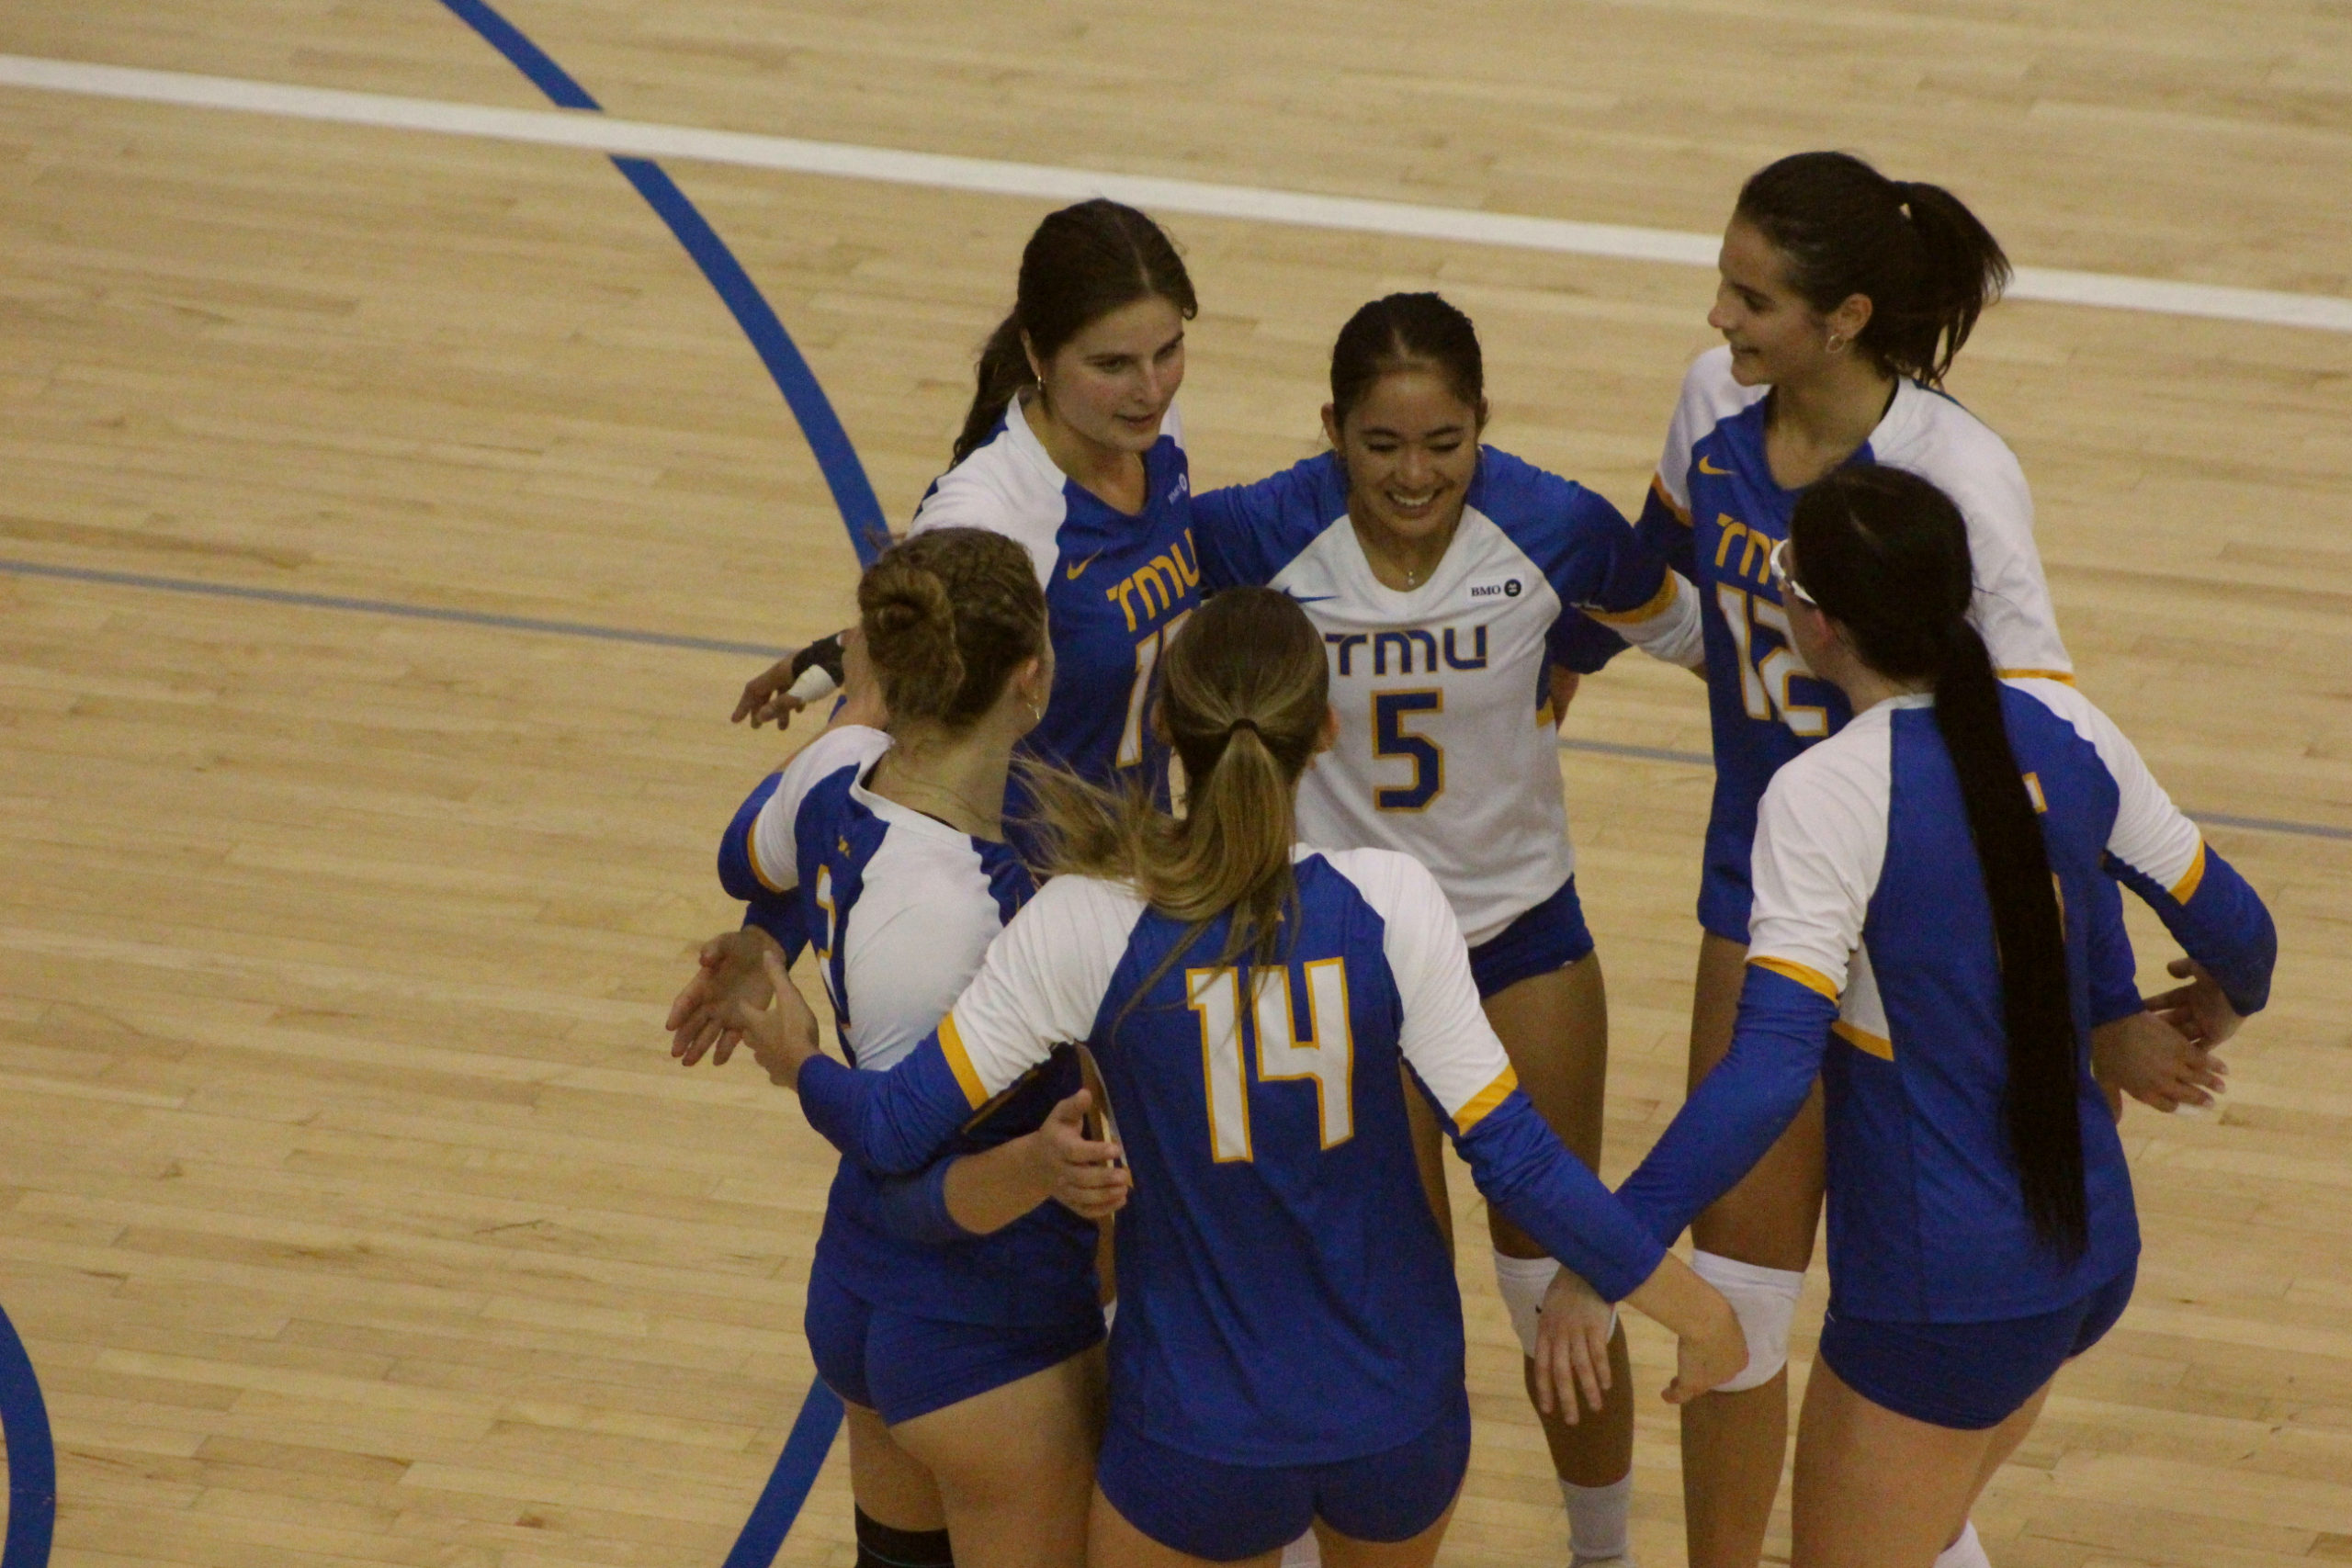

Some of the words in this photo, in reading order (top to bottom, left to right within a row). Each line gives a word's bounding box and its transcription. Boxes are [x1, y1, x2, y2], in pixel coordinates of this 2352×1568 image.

[1105, 527, 1200, 632] TMU
[1471, 585, 1501, 596] BMO
[1715, 513, 1788, 592] TM
[1115, 608, 1193, 769] 1
[1325, 625, 1487, 676] TMU
[1716, 581, 1829, 737] 12
[1370, 687, 1444, 813] 5
[1185, 956, 1354, 1164] 14
